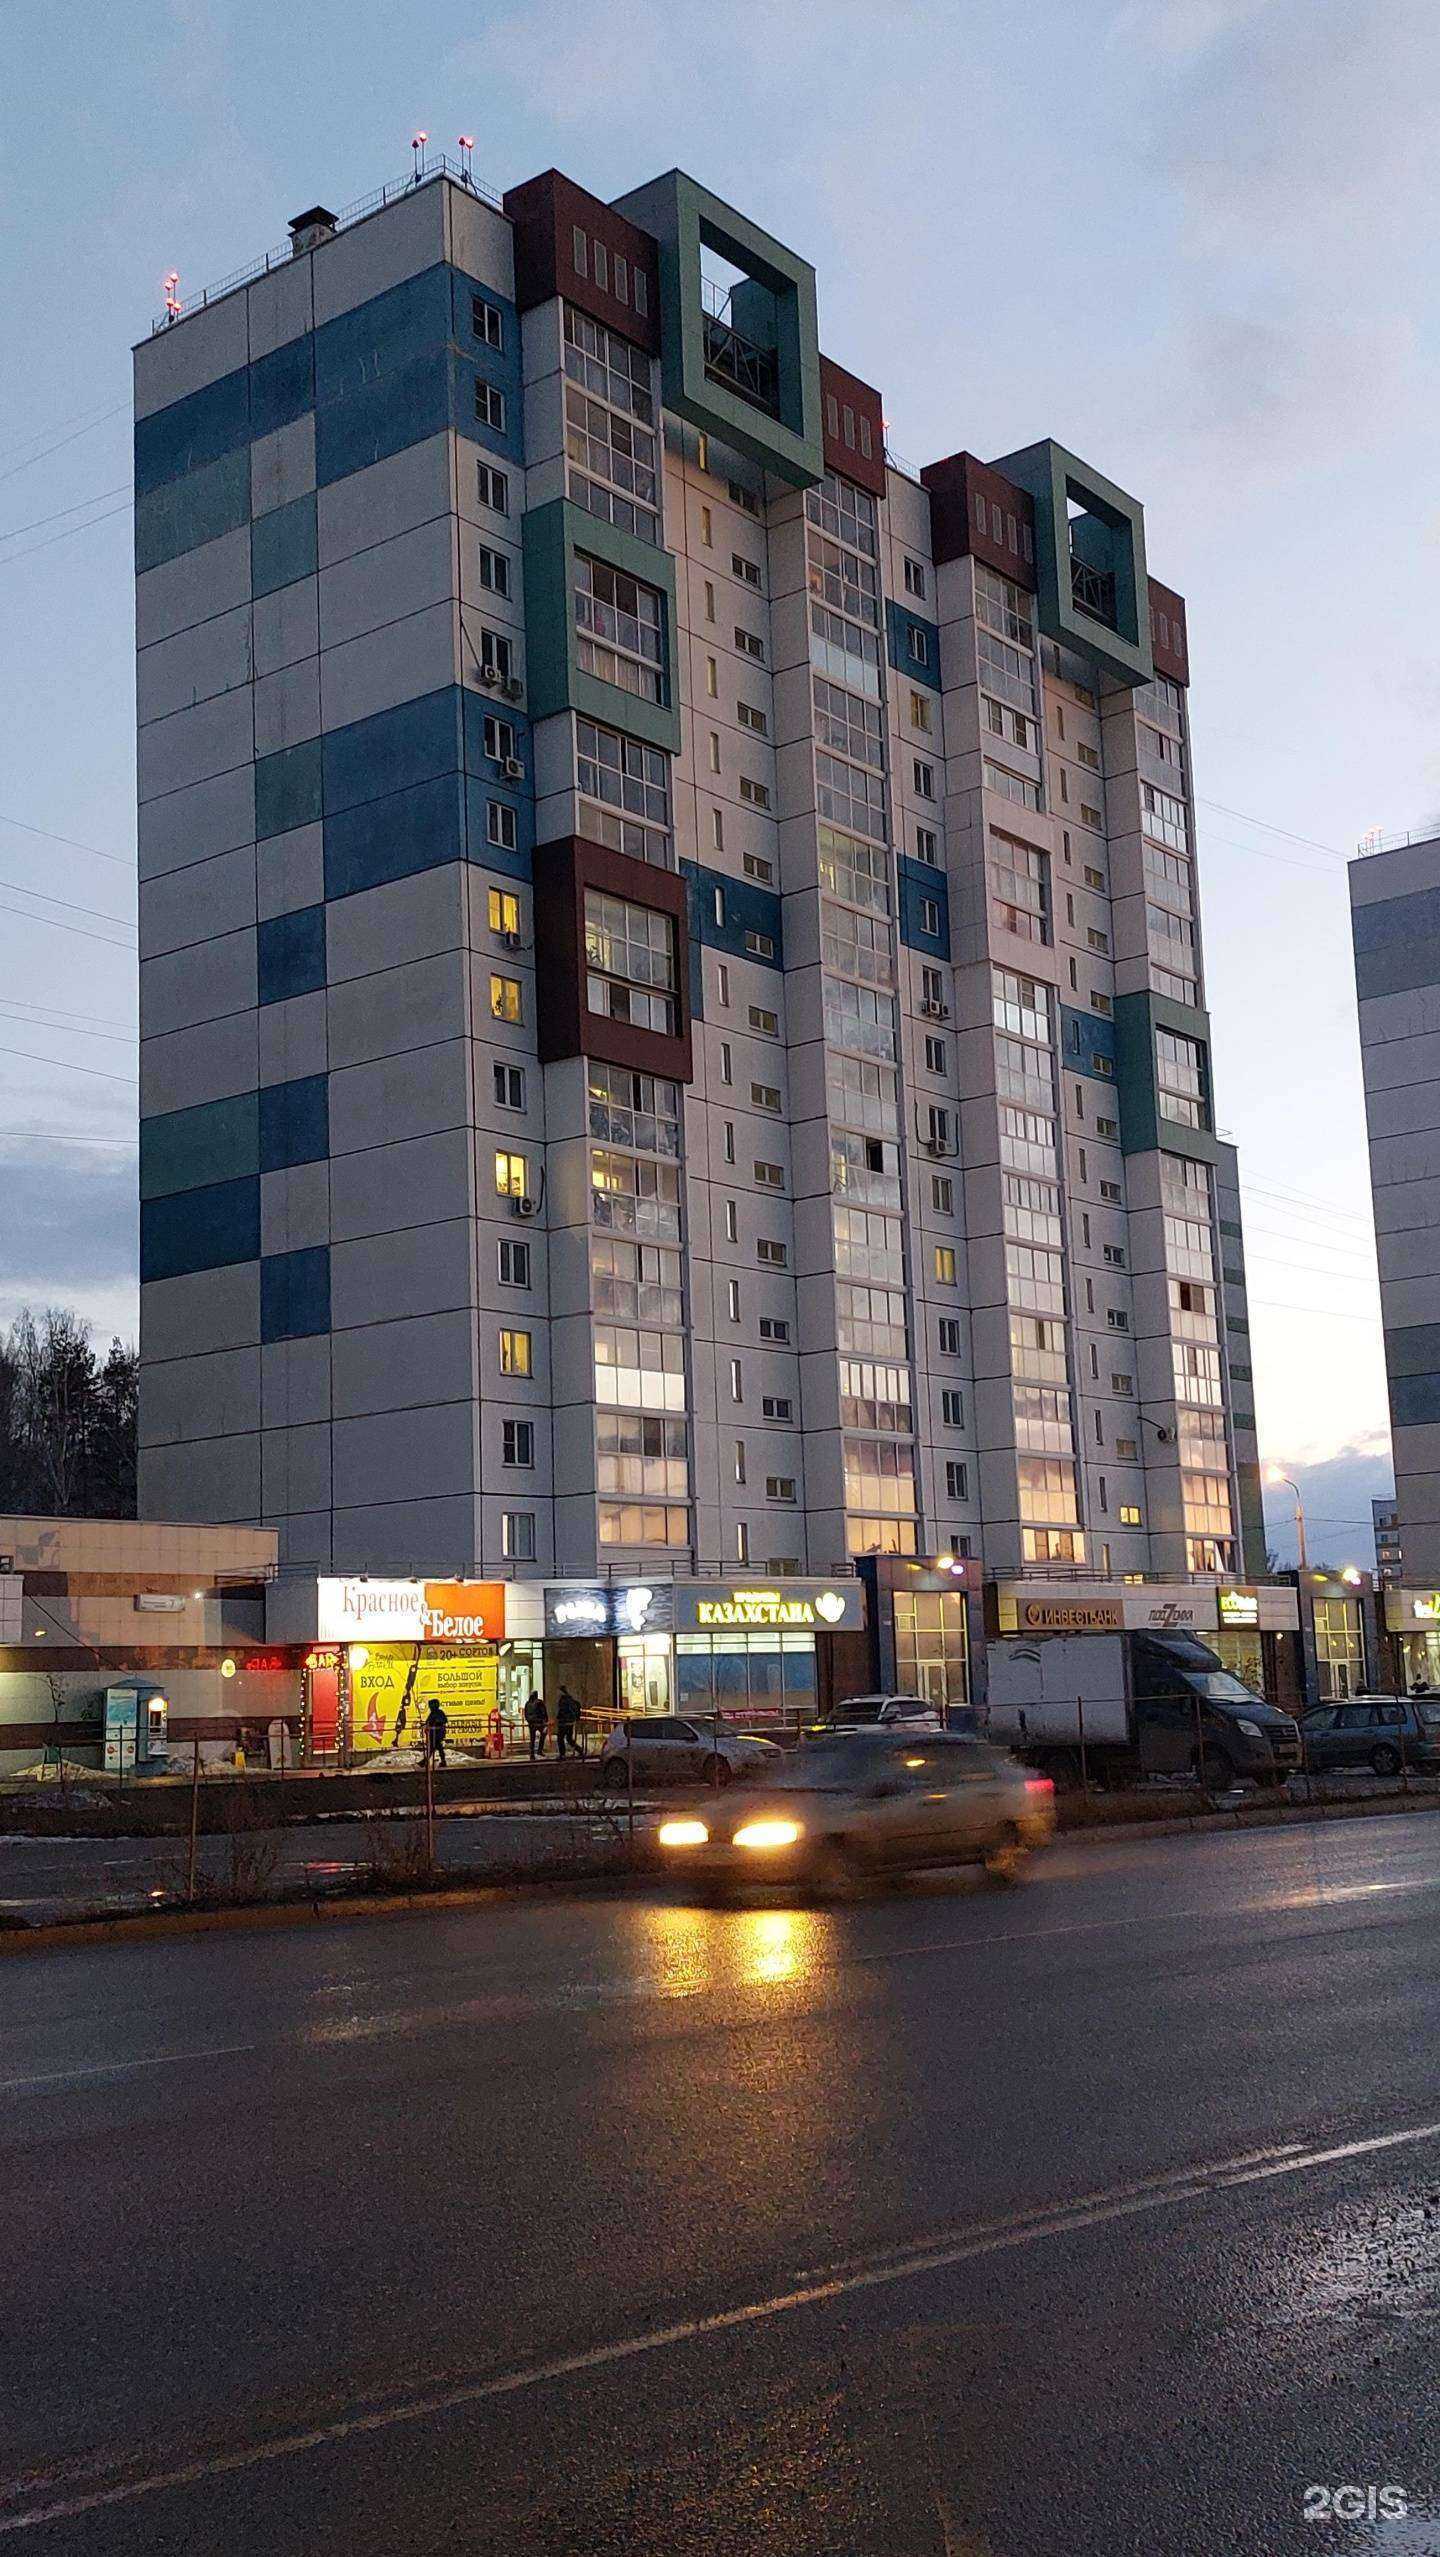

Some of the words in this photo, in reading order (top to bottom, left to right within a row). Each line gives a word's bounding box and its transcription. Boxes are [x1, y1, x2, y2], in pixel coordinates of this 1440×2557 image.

[343, 1586, 419, 1620] Красное
[698, 1602, 815, 1623] КАЗАХСТАНА
[431, 1610, 484, 1637] Белое
[1042, 1608, 1118, 1625] ИНВЕСТБАНК
[361, 1675, 394, 1689] ВХОД
[438, 1670, 483, 1681] БОЛЬШОЙ
